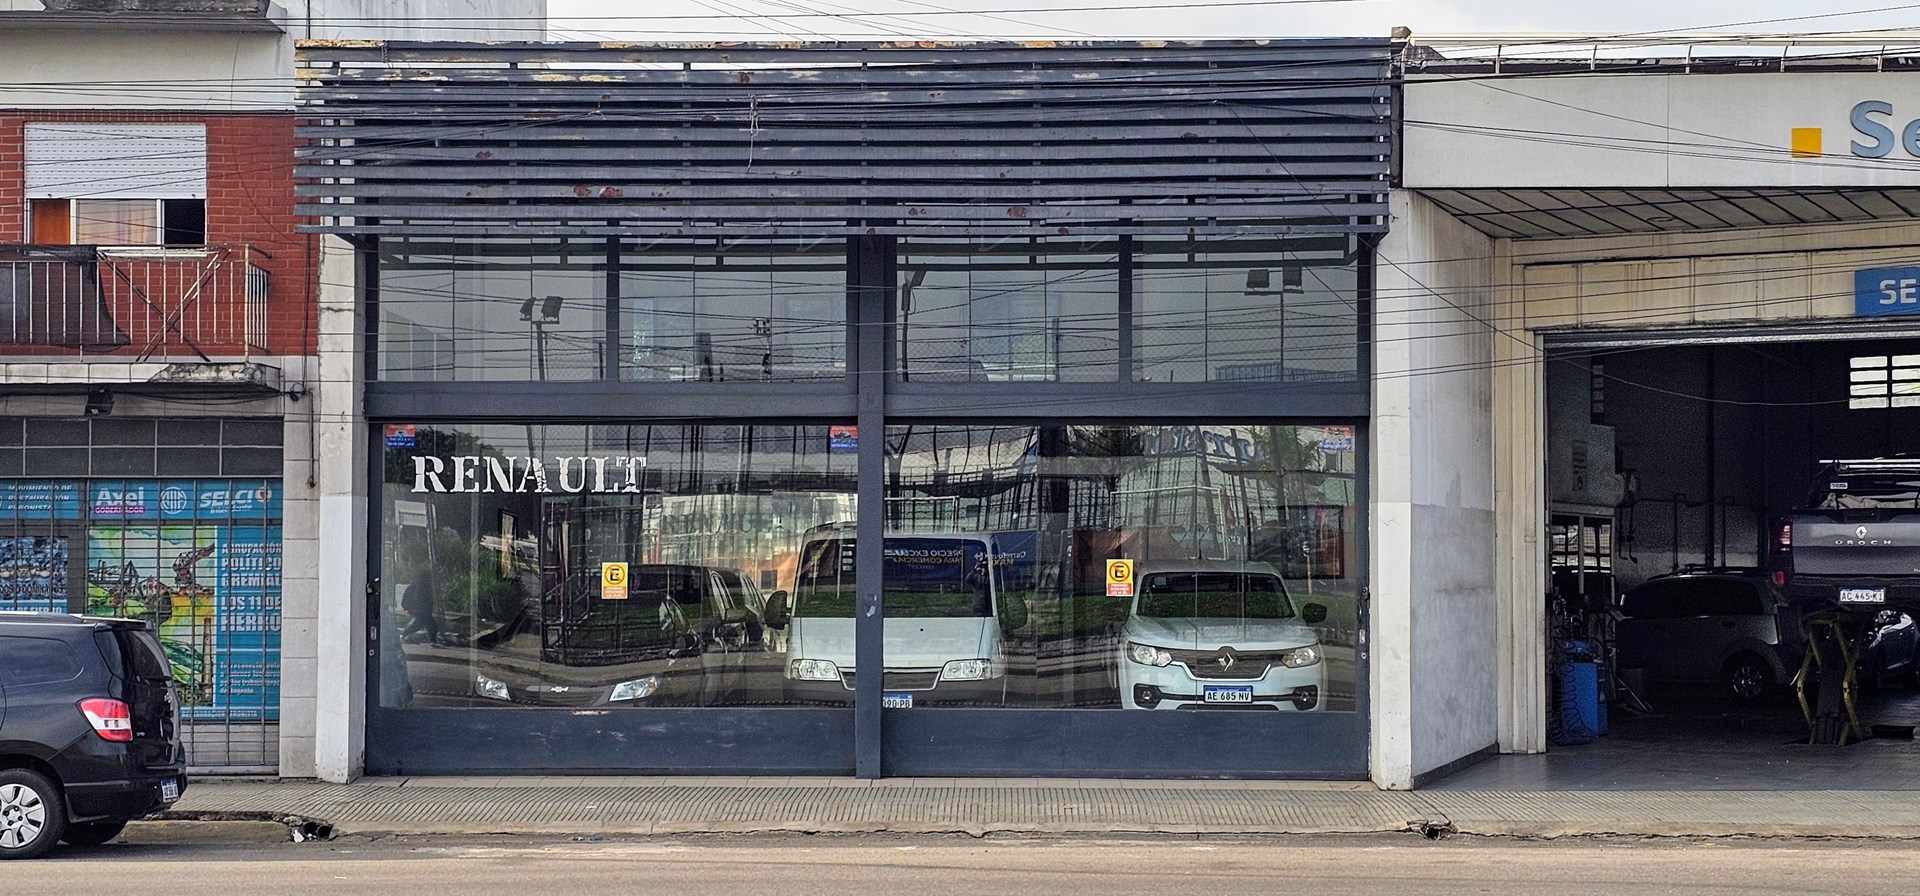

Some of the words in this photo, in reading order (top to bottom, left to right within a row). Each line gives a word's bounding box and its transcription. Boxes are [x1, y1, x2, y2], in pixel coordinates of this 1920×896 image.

[1879, 278, 1917, 304] SE
[411, 455, 647, 493] RENAULT
[200, 490, 254, 508] SELCI
[221, 597, 245, 610] LOS
[248, 597, 262, 610] 11
[265, 597, 281, 610] DE
[1855, 592, 1869, 600] 445
[1207, 692, 1217, 700] AE
[1220, 692, 1236, 700] 685
[1239, 692, 1249, 700] NV
